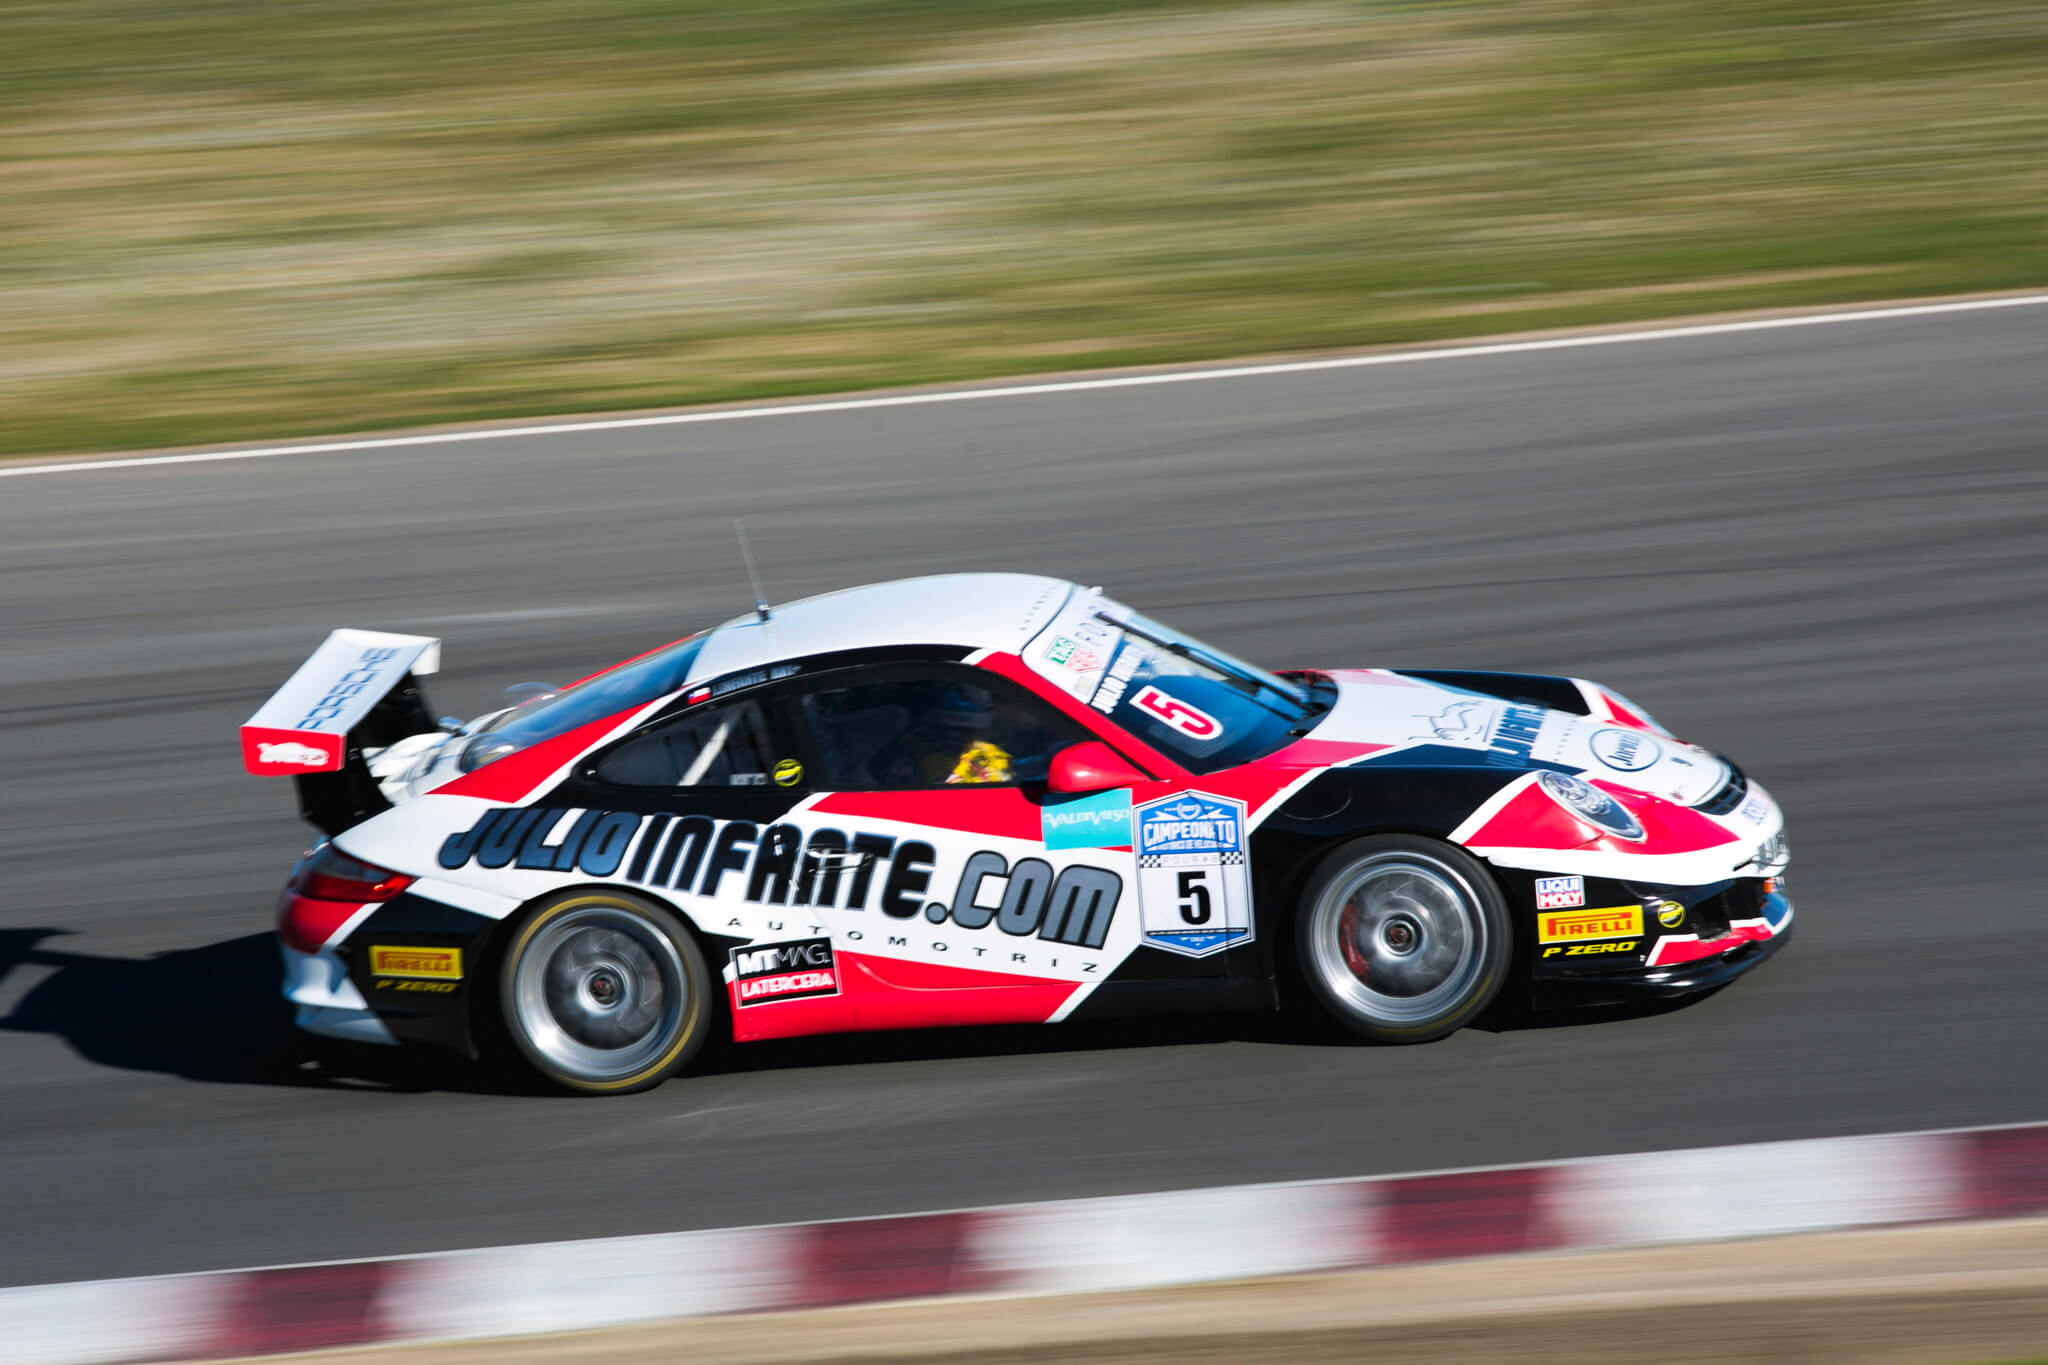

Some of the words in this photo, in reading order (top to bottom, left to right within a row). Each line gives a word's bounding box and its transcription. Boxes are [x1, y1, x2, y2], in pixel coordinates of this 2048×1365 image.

[294, 647, 401, 730] PORSCHE
[1138, 690, 1214, 737] 5
[1143, 820, 1236, 847] CAMPEONATO
[1177, 870, 1211, 926] 5
[1539, 878, 1579, 893] LIQUI
[1540, 891, 1583, 907] MOLY
[1546, 912, 1633, 937] PIRELLI
[727, 917, 1100, 973] AUTOMOTRIZ
[1542, 946, 1562, 958] P
[1565, 941, 1637, 957] ZERO
[377, 951, 453, 972] PIRELLI
